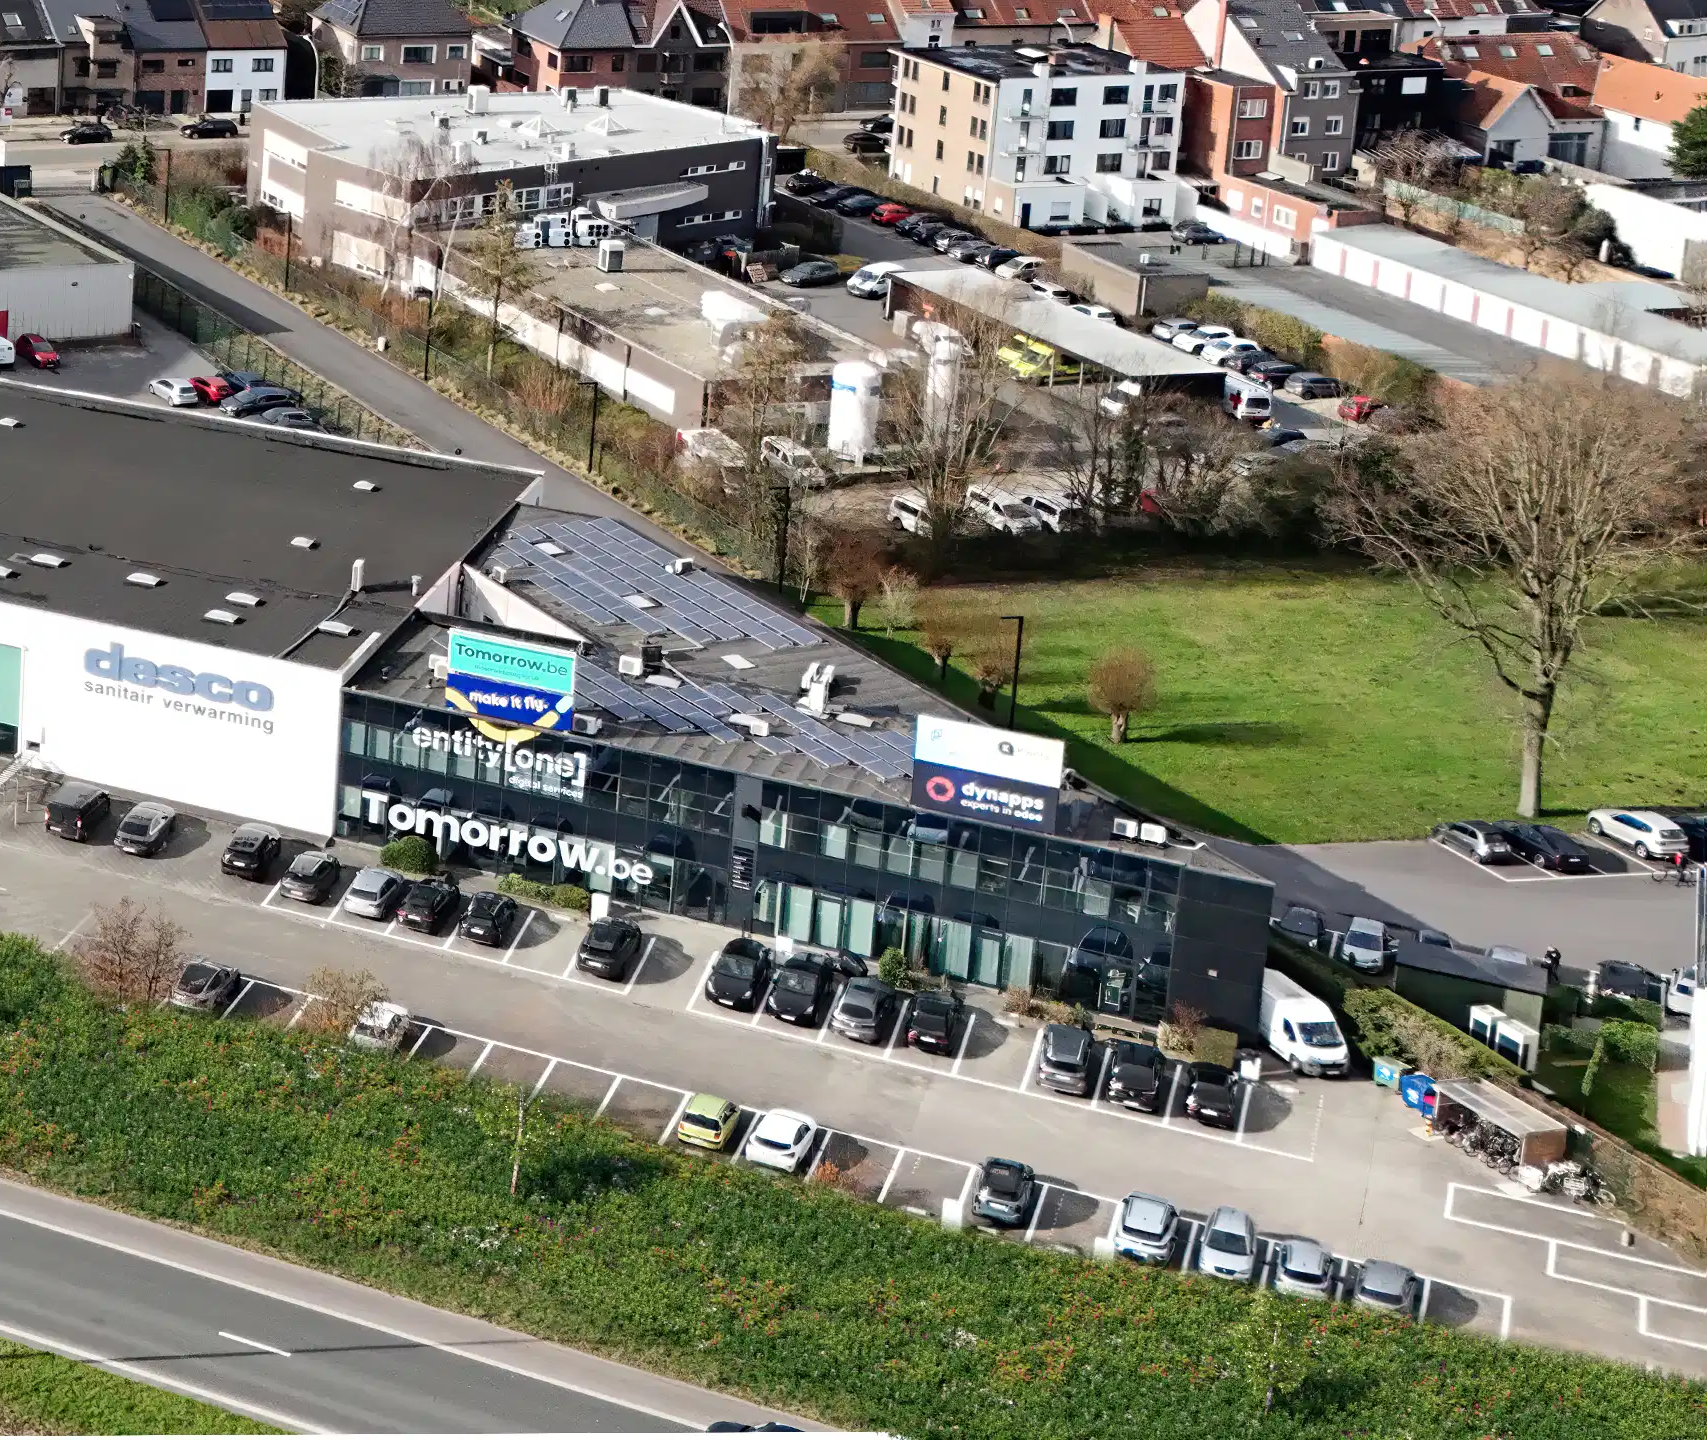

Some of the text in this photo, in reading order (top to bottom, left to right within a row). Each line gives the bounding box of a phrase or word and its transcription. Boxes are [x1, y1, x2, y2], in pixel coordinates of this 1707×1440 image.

[455, 642, 568, 676] Tomorrow.be
[84, 641, 275, 712] desco
[84, 681, 274, 735] sanitair verwarming
[469, 691, 509, 708] make
[510, 694, 522, 709] it
[412, 726, 587, 787] entity[one]
[508, 775, 584, 800] digital services
[961, 781, 1044, 811] dynapps
[960, 798, 1043, 822] experts in odoo
[362, 790, 653, 885] Tomorrow.be
